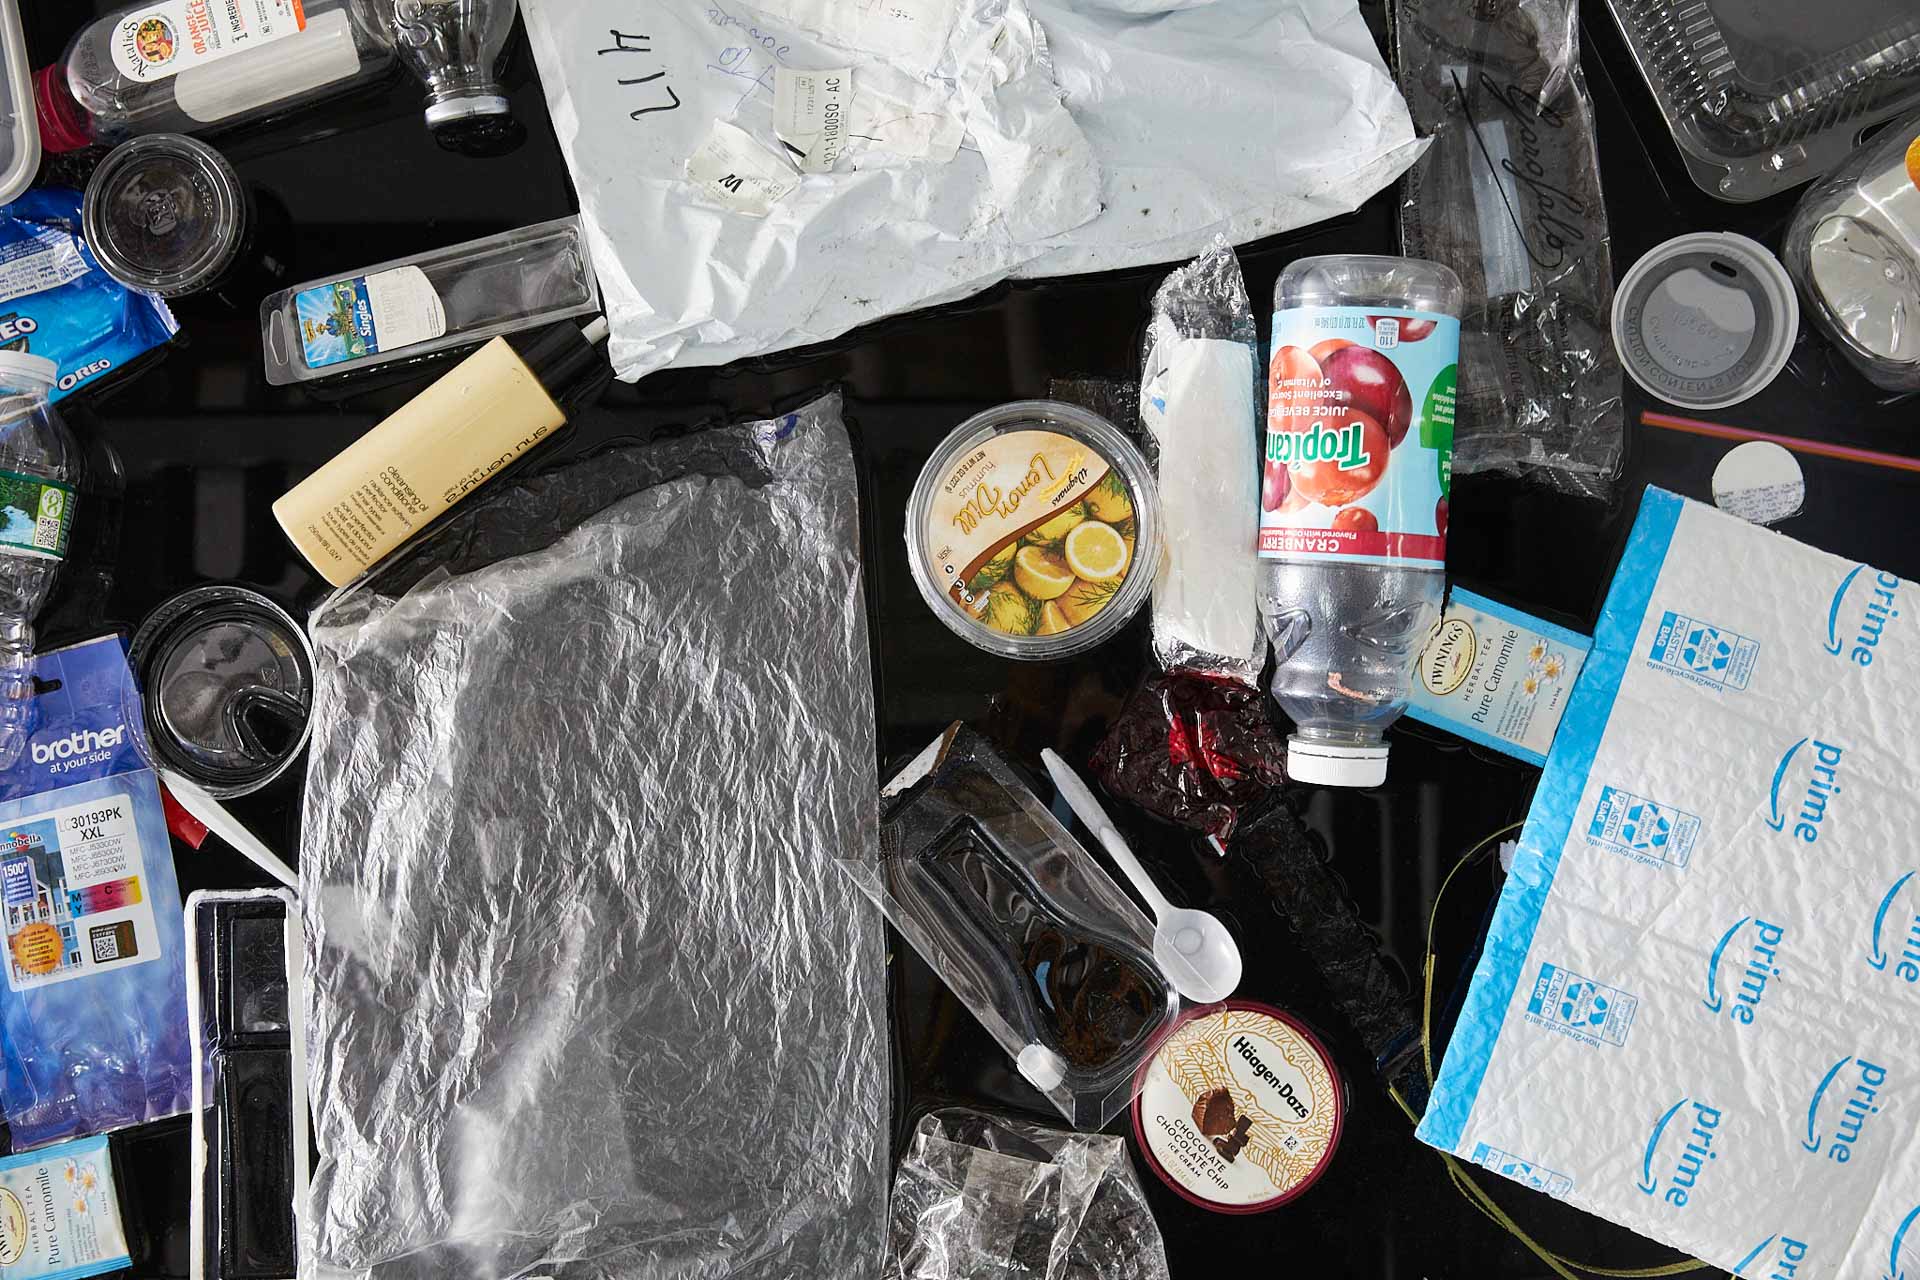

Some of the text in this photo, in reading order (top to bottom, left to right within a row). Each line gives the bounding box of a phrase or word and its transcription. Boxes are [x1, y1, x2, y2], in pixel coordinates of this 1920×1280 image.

[186, 14, 207, 55] ORANGE
[191, 0, 212, 33] JUICE
[225, 0, 240, 33] INGREDIE
[825, 77, 841, 94] AC
[1480, 71, 1586, 268] Garofalo
[0, 316, 38, 342] EO
[357, 299, 372, 337] Singles
[1379, 336, 1393, 345] 110
[57, 358, 111, 391] OREO
[1284, 378, 1317, 388] Vitamin
[1319, 377, 1330, 387] of
[1268, 405, 1348, 417] JUICE BEVERAG
[1292, 389, 1342, 400] Excellent
[513, 424, 550, 452] shu
[1266, 422, 1370, 472] Tropican
[367, 479, 394, 508] radiance
[378, 470, 420, 516] conditioner
[384, 465, 423, 507] cleansing
[959, 460, 997, 499] hummus
[1000, 452, 1055, 519] Lemon
[1052, 467, 1088, 506] Wegmans
[360, 484, 389, 515] perfector
[953, 483, 1001, 535] Dill
[349, 514, 379, 544] perfection
[1262, 536, 1339, 552] CRANBERRY
[1322, 531, 1356, 539] Flavored
[1431, 624, 1464, 686] TWININGS
[1657, 625, 1669, 648] BAG
[1666, 620, 1685, 661] PLASTIC
[1464, 637, 1493, 702] HERBAL TEA
[1472, 629, 1519, 723] Pure Camomile
[30, 724, 126, 765] brother
[50, 749, 112, 774] at your side
[1794, 738, 1842, 844] prime
[1597, 801, 1608, 823] BAG
[1606, 794, 1625, 837] PASTIC
[0, 834, 41, 851] nnobella
[80, 823, 105, 841] XXL
[71, 885, 114, 903] M C
[74, 904, 84, 915] Y
[1536, 977, 1547, 1000] BAG
[1729, 919, 1784, 1026] prime
[1545, 973, 1563, 1015] PLASTIC
[1233, 1035, 1310, 1120] Häagen-Dazs
[1828, 1058, 1887, 1165] prime
[1155, 1115, 1229, 1191] CHOCOLATE CHIP
[1167, 1142, 1203, 1178] ICE CREAM
[1174, 1118, 1227, 1173] CHOCOLATE
[1664, 1101, 1722, 1208] prime
[24, 1186, 40, 1253] HERBAL TEA
[35, 1167, 61, 1265] Pure Camomile
